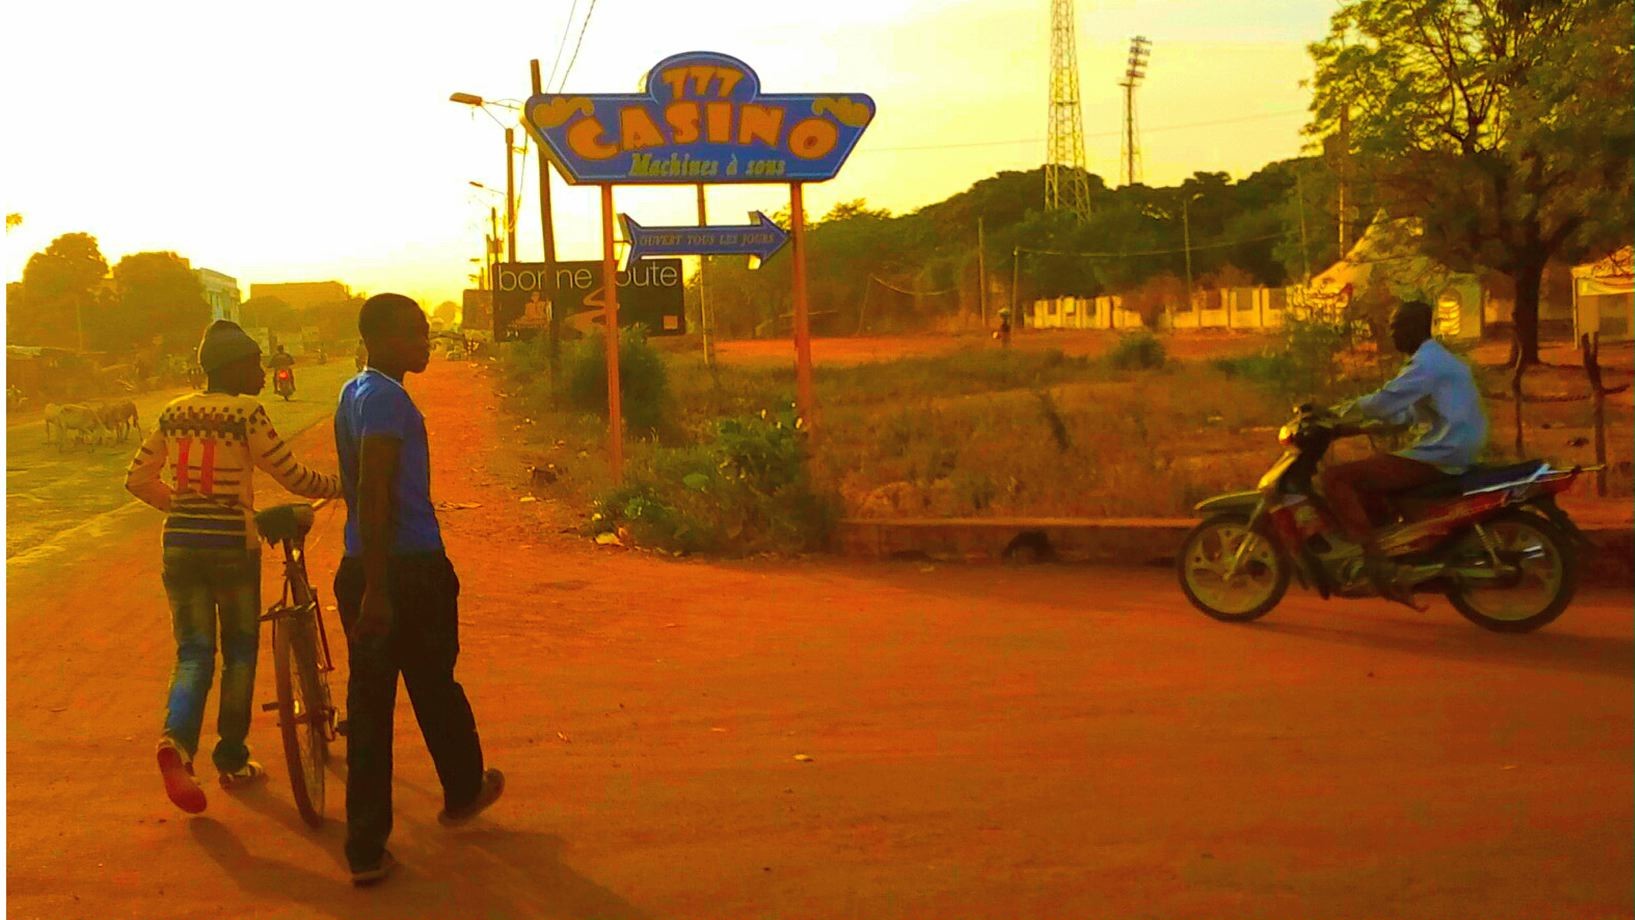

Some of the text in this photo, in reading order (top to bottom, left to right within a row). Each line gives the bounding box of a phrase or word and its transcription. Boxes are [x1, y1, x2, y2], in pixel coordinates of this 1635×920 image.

[661, 65, 745, 99] 777
[567, 102, 839, 160] CASINO
[628, 152, 719, 177] Machines
[725, 152, 738, 176] à
[639, 233, 776, 246] OUVERT TOUS LES JOURS
[614, 261, 678, 287] oute
